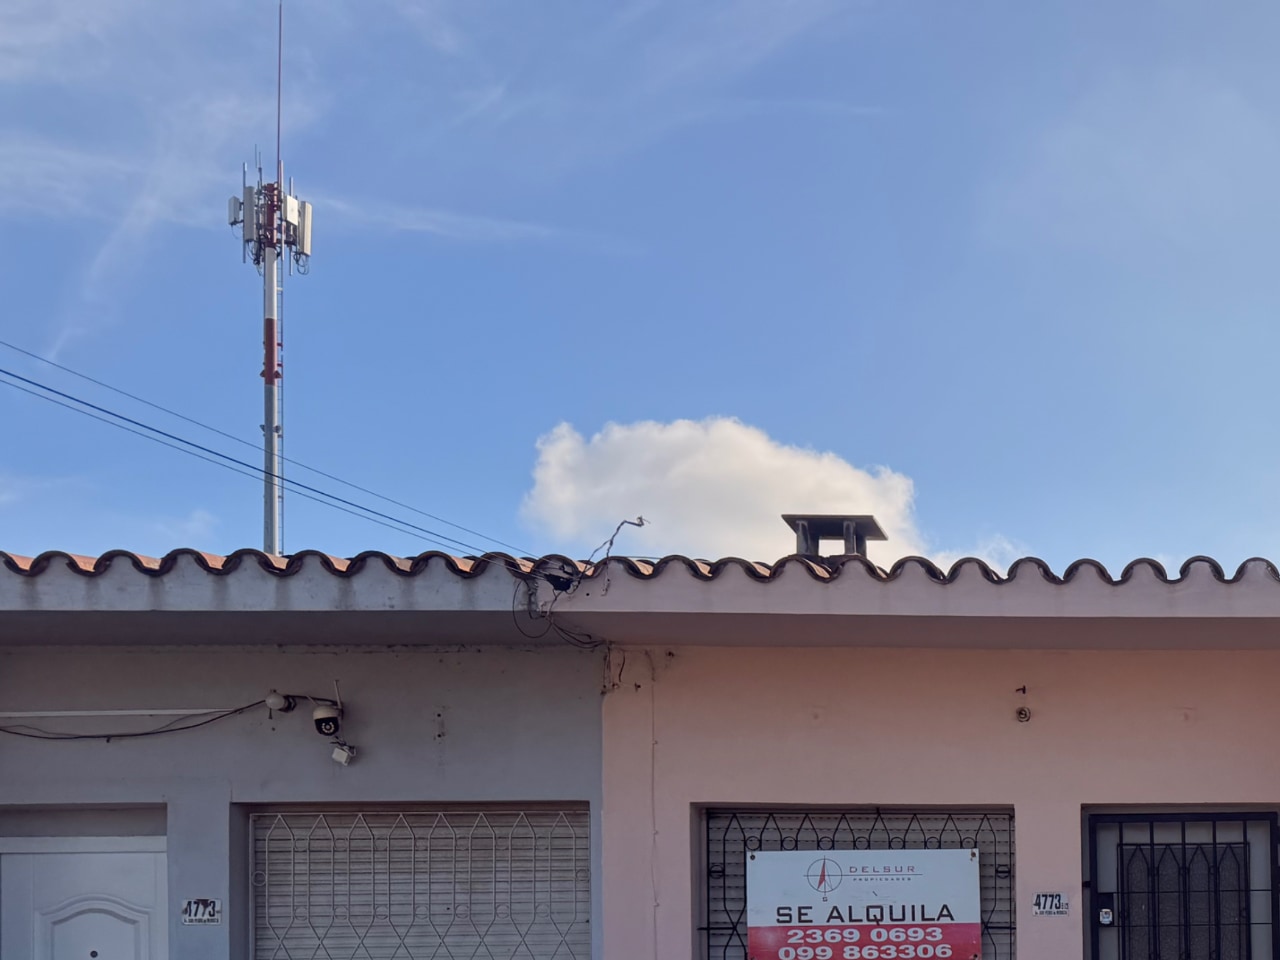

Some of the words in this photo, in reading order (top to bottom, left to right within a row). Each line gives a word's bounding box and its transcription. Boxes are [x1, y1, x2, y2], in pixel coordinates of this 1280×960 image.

[849, 865, 915, 873] DELSUR
[1033, 893, 1061, 910] 4773
[776, 906, 813, 924] SE
[826, 904, 955, 926] ALQUILA
[787, 928, 860, 944] 2369
[870, 927, 943, 943] 0693
[778, 946, 833, 960] 099
[842, 944, 953, 960] 863306
